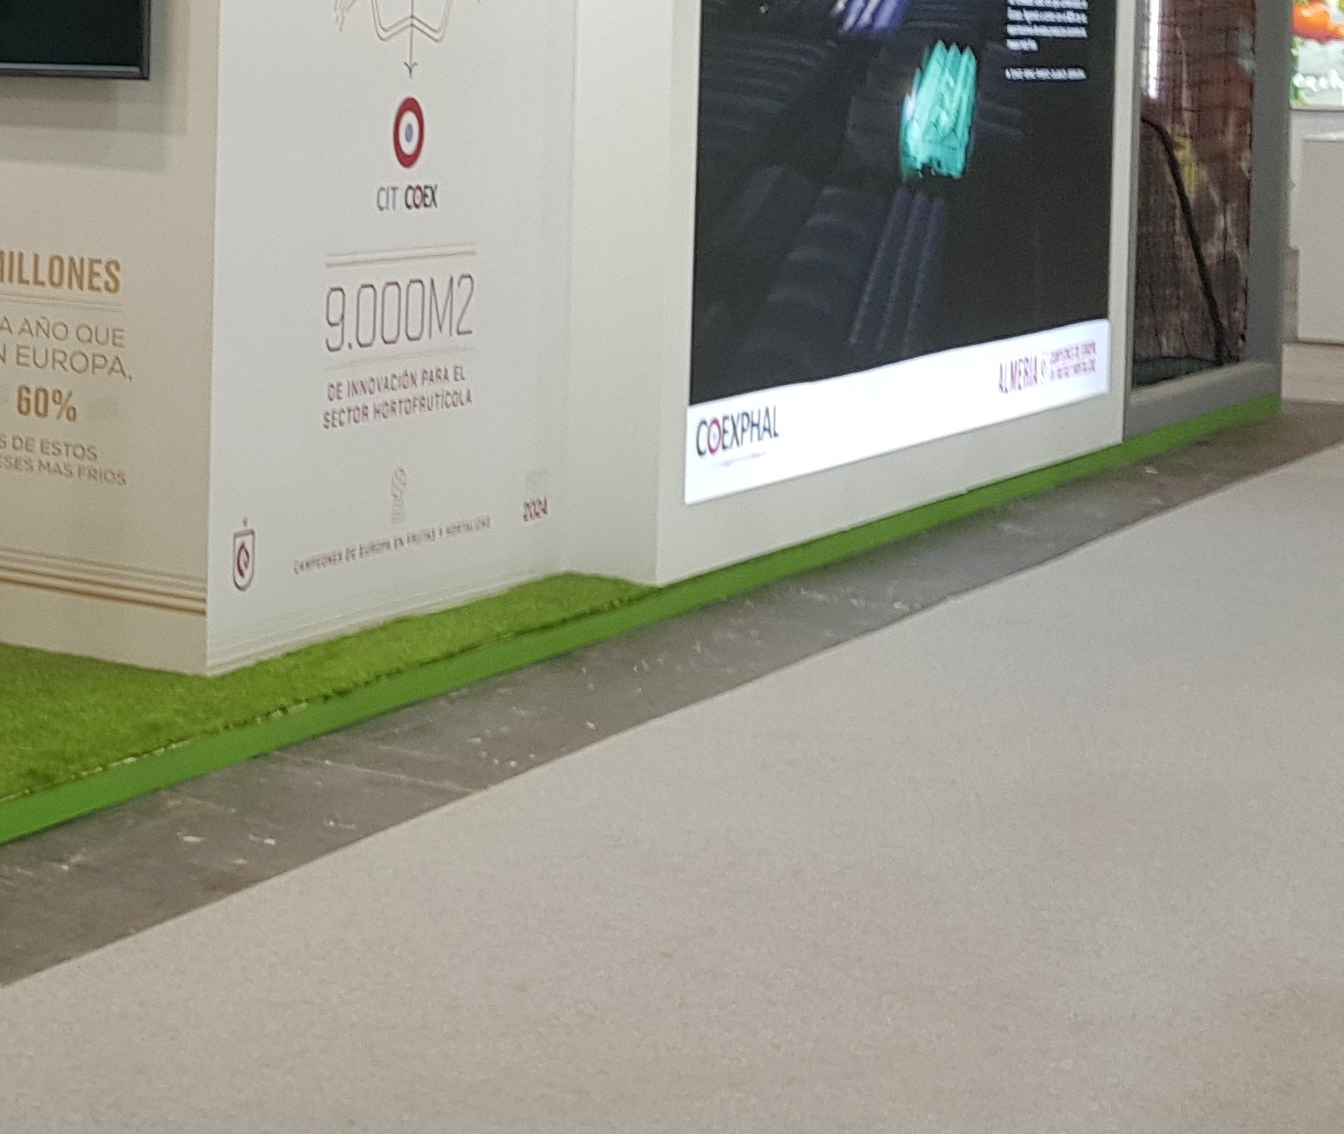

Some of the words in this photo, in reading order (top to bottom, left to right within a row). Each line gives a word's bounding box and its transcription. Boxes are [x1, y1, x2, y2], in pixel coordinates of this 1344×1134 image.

[376, 186, 399, 212] CIT
[404, 183, 439, 210] COEX
[324, 273, 476, 353] 9.000M2
[17, 316, 69, 342] AÑO
[75, 323, 127, 349] QUE
[15, 344, 133, 382] EUROPA,
[327, 380, 343, 403] DE
[347, 369, 418, 399] INNOVACIÓN
[421, 365, 450, 388] PARA
[453, 365, 466, 383] EL
[16, 384, 78, 423] 60%
[323, 404, 369, 430] SECTOR
[11, 434, 36, 453] DE
[40, 437, 99, 462] ESTOS
[696, 405, 779, 458] COEXPHAL
